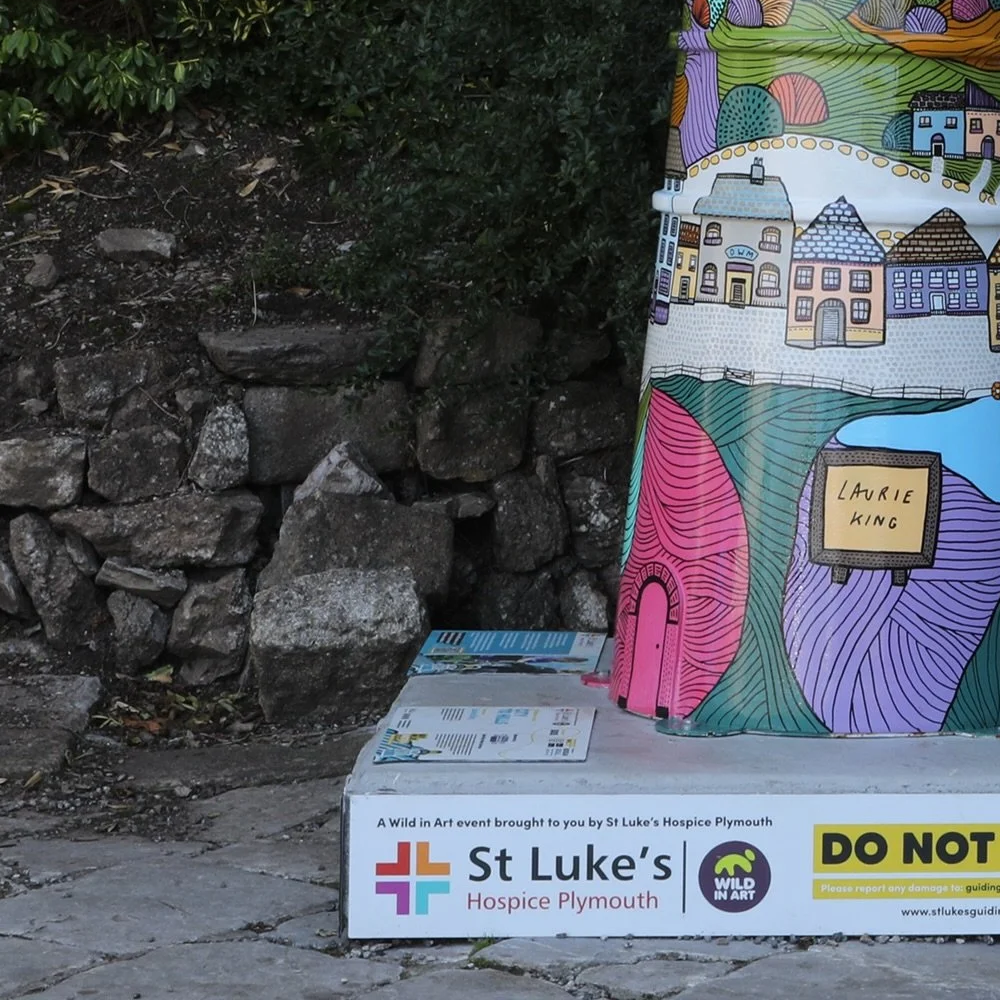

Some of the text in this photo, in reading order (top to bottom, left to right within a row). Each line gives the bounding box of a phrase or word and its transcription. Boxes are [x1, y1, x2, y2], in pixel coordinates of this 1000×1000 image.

[837, 480, 915, 504] LAURIE
[849, 512, 898, 530] KING
[377, 816, 773, 830] A Wild in Art event brought to you by St Luke's Hospice Plymouth
[822, 832, 889, 865] DO
[903, 831, 996, 865] NOT
[469, 844, 673, 883] St Luke's
[714, 877, 755, 890] WILD
[820, 883, 853, 893] Please
[855, 884, 887, 896] report
[888, 886, 906, 896] any
[908, 883, 946, 895] damage
[948, 884, 964, 893] to:
[468, 890, 659, 915] Hospice Plymouth
[714, 890, 756, 901] IN ART
